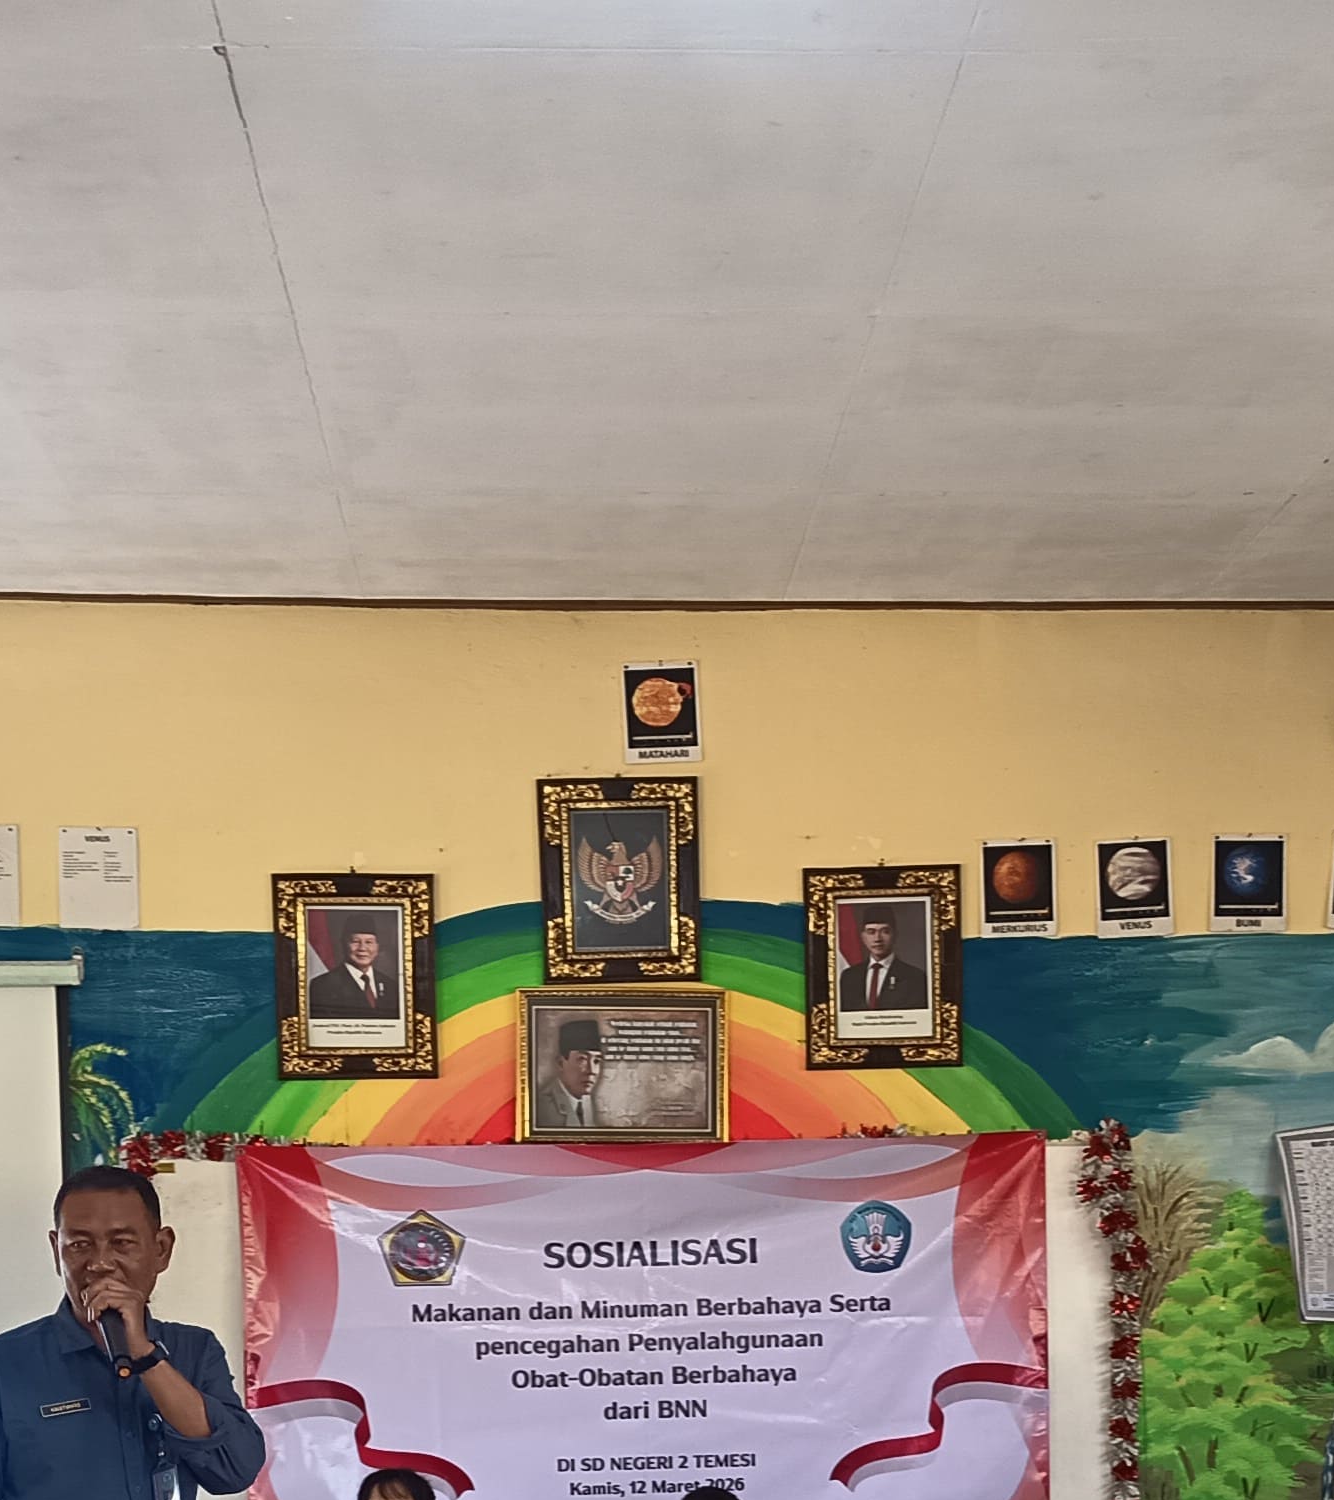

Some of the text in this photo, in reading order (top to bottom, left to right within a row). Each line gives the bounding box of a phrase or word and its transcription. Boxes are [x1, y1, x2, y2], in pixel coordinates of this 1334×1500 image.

[638, 749, 689, 759] MATAHARI
[991, 923, 1048, 934] MERKURIUS
[1119, 920, 1153, 931] VENUS
[1236, 918, 1262, 928] BUMI
[543, 1237, 759, 1269] SOSIALISASI
[412, 1294, 891, 1322] Makanan dan Minuman Berbahaya Serta
[475, 1331, 823, 1360] pencegahan Penyalahgunaan
[511, 1365, 796, 1389] Obat-Obatan Berbahaya
[603, 1400, 707, 1420] dari BNN
[557, 1453, 756, 1472] DI SD NEGERI 2 TEMESI
[570, 1477, 745, 1497] Kamis, 12 Maret 2026
